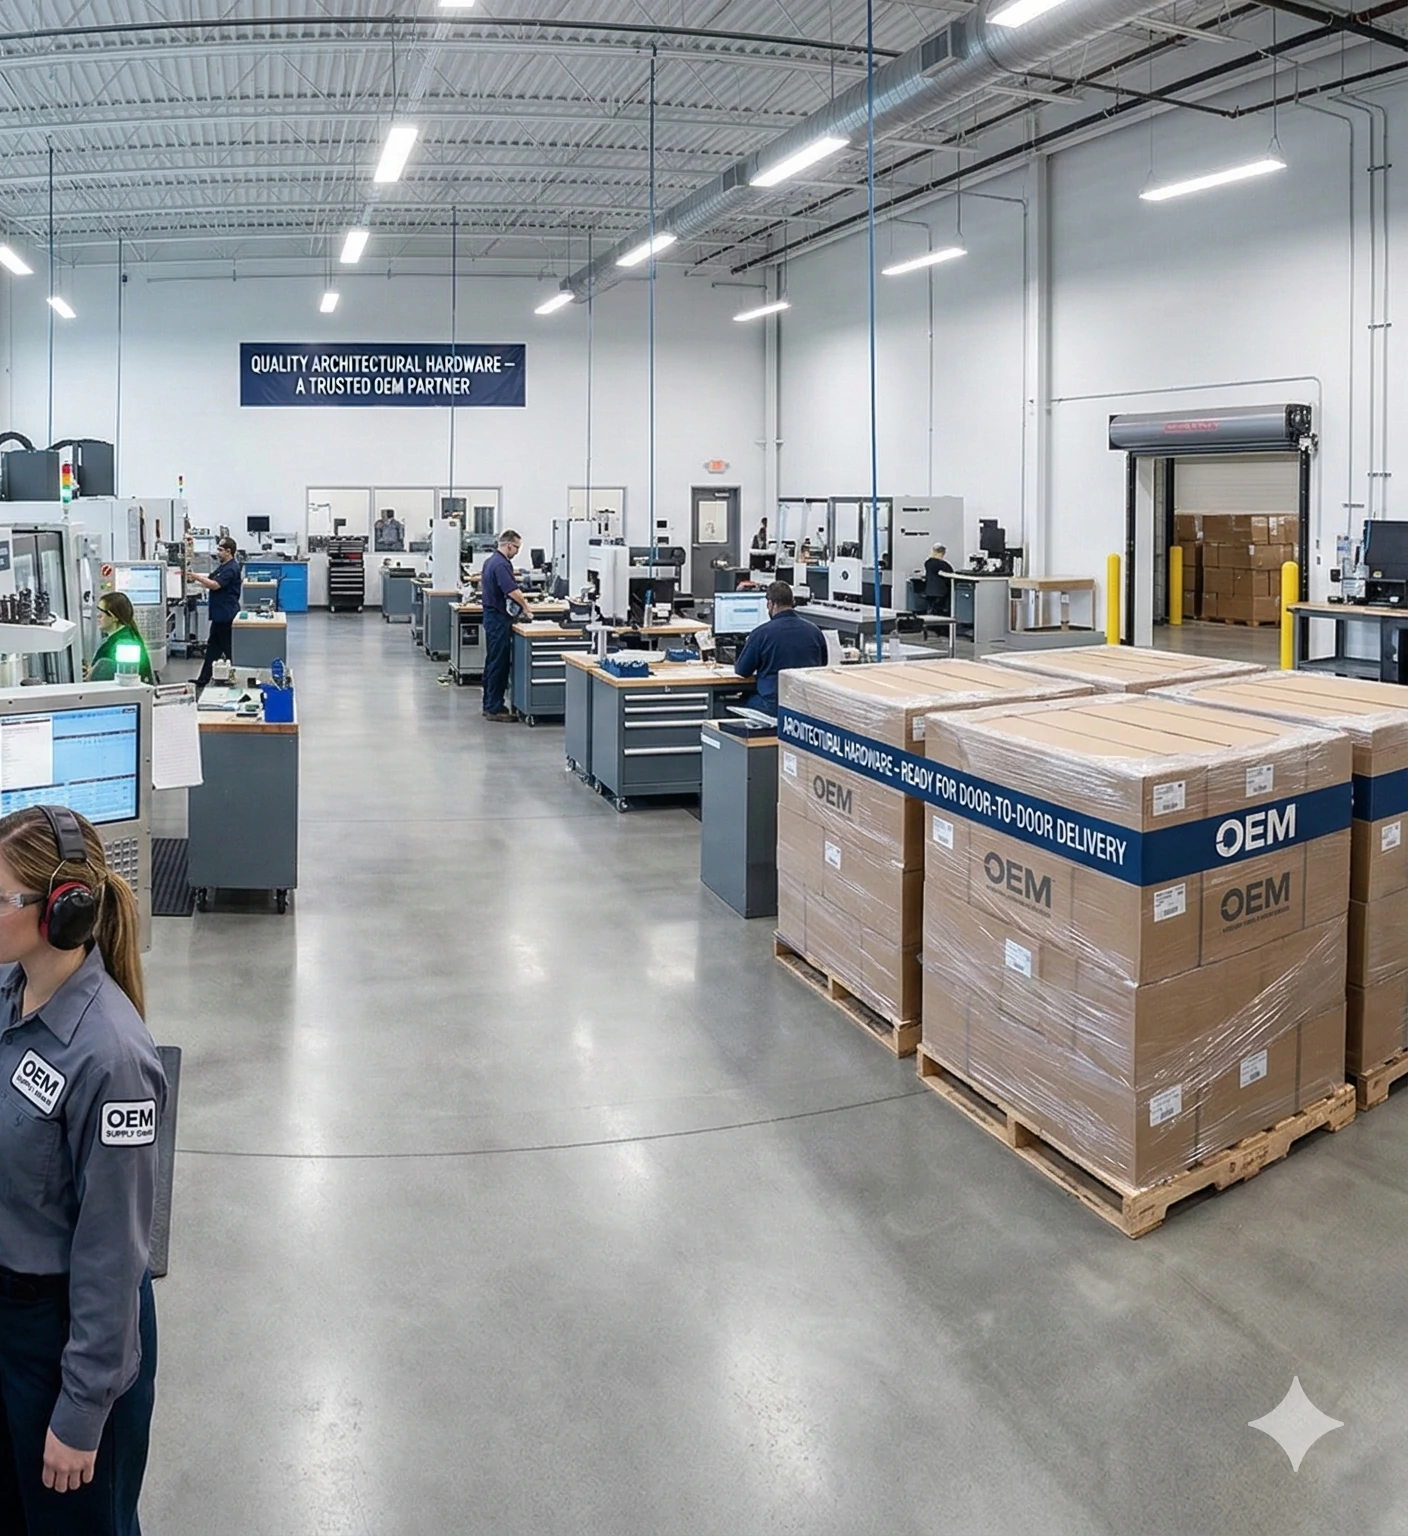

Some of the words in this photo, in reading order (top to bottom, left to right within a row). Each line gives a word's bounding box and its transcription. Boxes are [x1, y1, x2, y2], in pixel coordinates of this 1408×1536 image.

[251, 355, 308, 374] QUALITY
[311, 355, 422, 373] ARCHITECTURAL
[426, 355, 501, 373] HARDWARE
[295, 377, 305, 395] A
[309, 377, 370, 395] TRUSTED
[375, 377, 403, 395] OEM
[407, 377, 470, 395] PARTNER
[813, 775, 853, 815] OEM
[901, 760, 933, 793] READY
[935, 773, 957, 803] FOR
[959, 783, 1053, 840] DOOR-TO-DOOR
[1056, 819, 1127, 866] DELIVERY
[1216, 804, 1297, 858] OEM
[984, 851, 1052, 909] OEM
[1220, 872, 1291, 922] OEM
[22, 1060, 60, 1097] OEM
[107, 1108, 153, 1128] OEM
